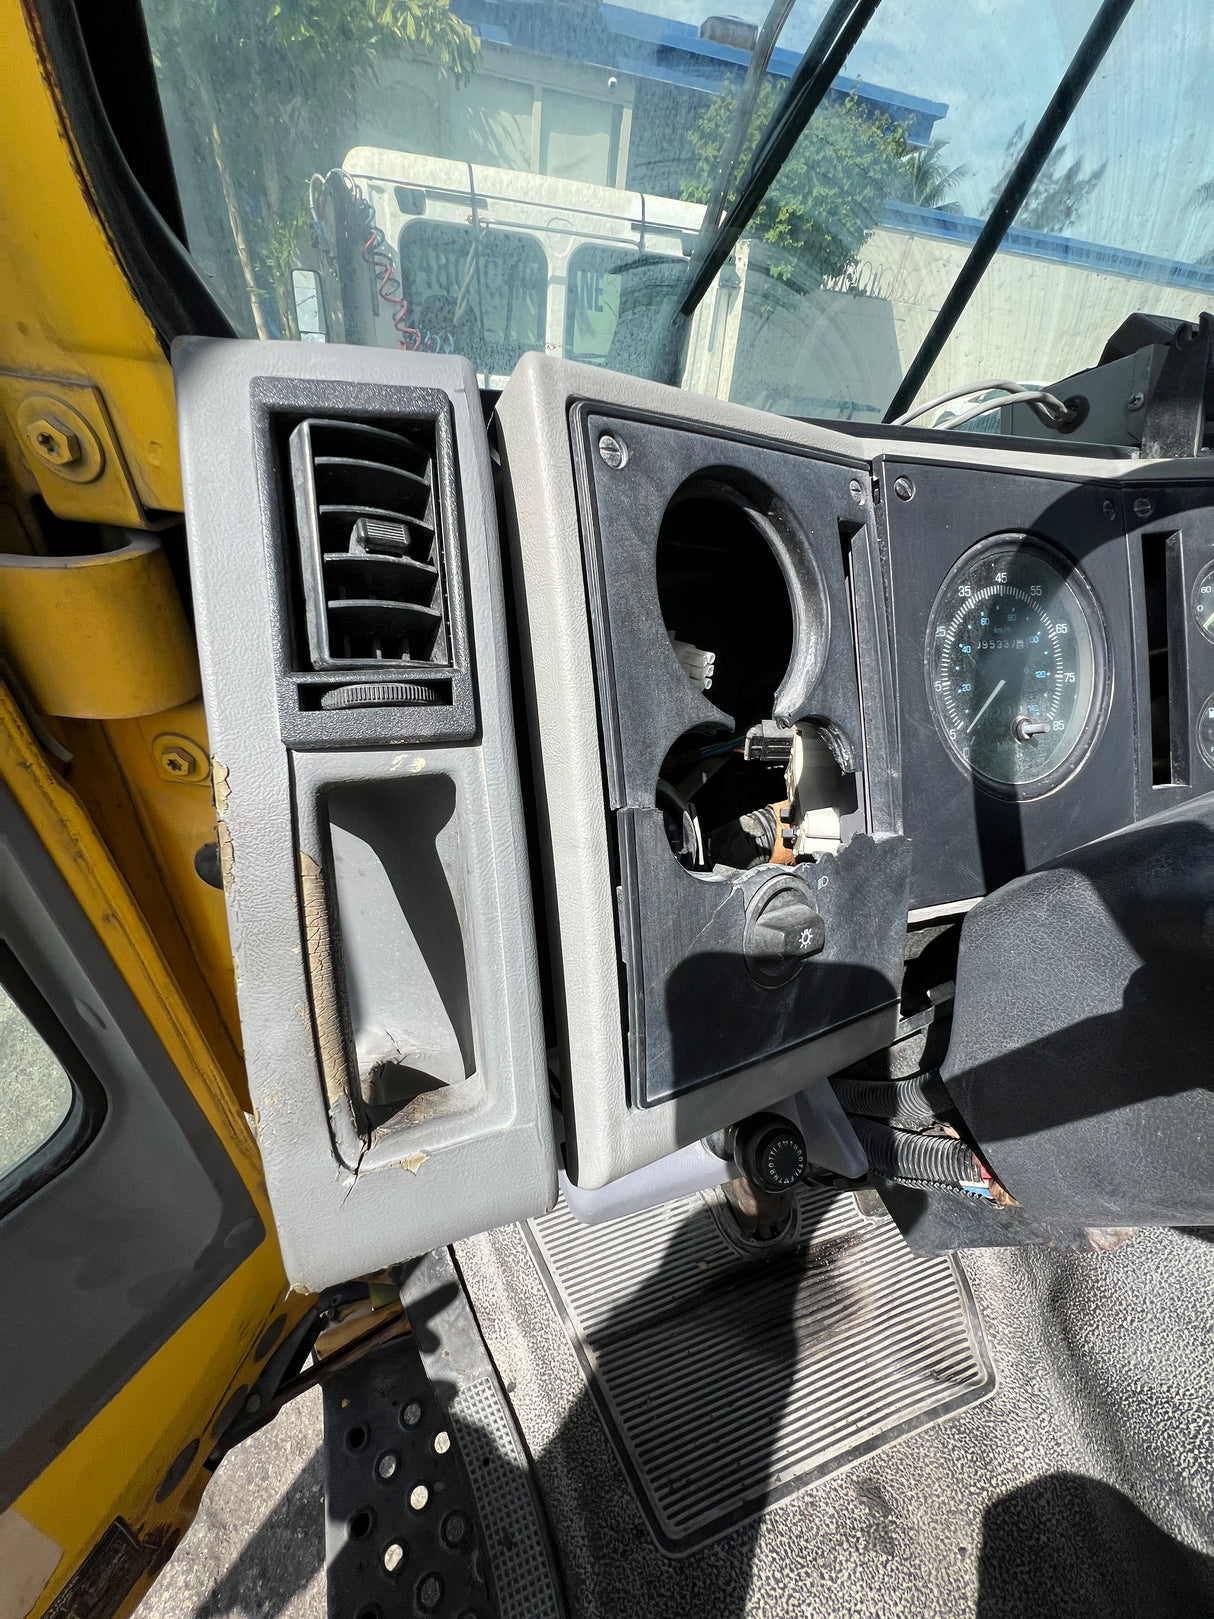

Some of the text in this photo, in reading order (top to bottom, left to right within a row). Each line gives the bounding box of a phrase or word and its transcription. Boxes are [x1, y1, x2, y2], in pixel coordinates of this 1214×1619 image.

[995, 573, 1007, 583] 45
[958, 585, 971, 597] 35
[1030, 585, 1042, 596] 55
[1055, 624, 1067, 634] 65
[961, 645, 971, 654] 40
[1064, 673, 1075, 683] 75
[962, 683, 971, 692] 20
[1053, 721, 1064, 731] 85
